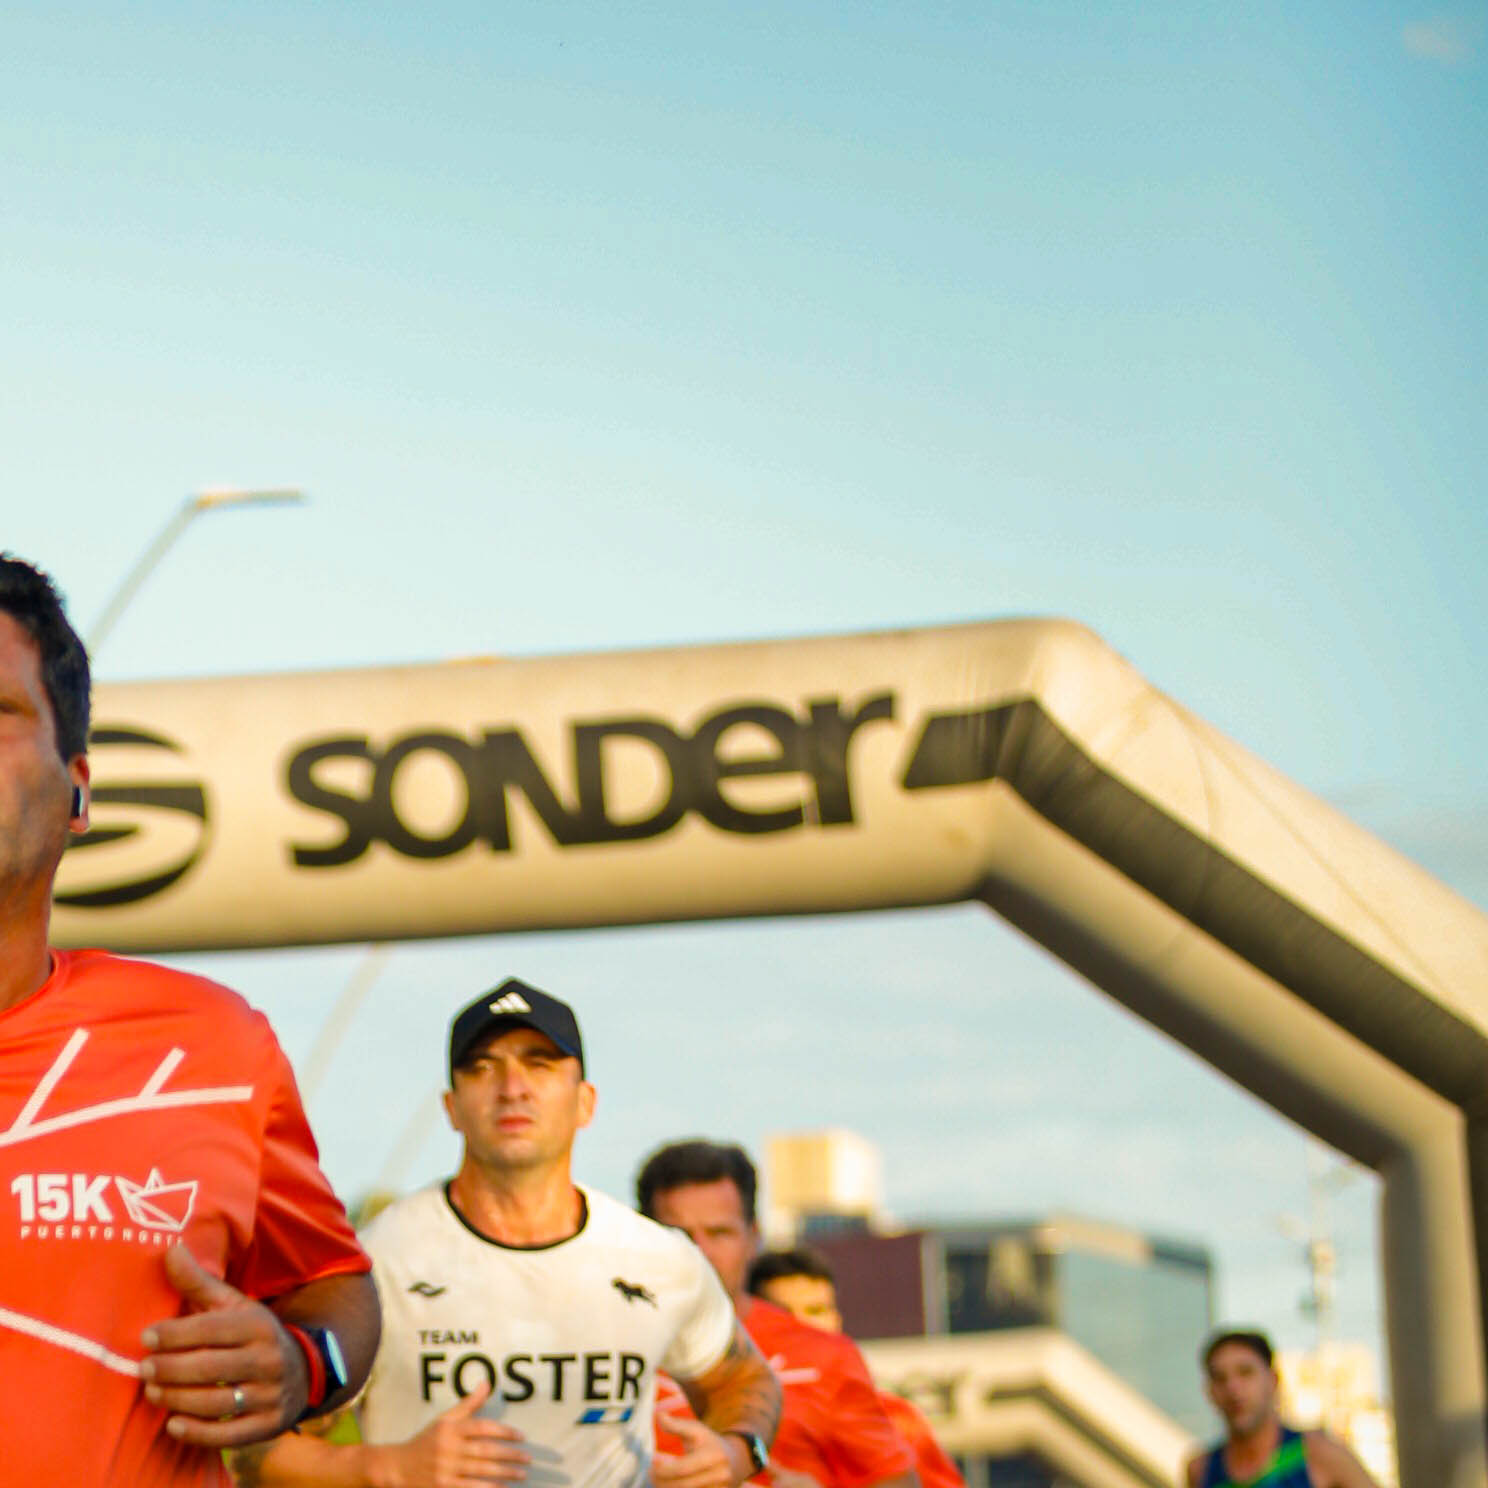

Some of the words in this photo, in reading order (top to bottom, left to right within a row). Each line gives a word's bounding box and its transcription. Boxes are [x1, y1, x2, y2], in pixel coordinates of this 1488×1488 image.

[11, 1173, 114, 1222] 15K
[20, 1225, 114, 1240] PUERTO
[419, 1330, 480, 1345] TEAM
[420, 1352, 645, 1403] FOSTER
